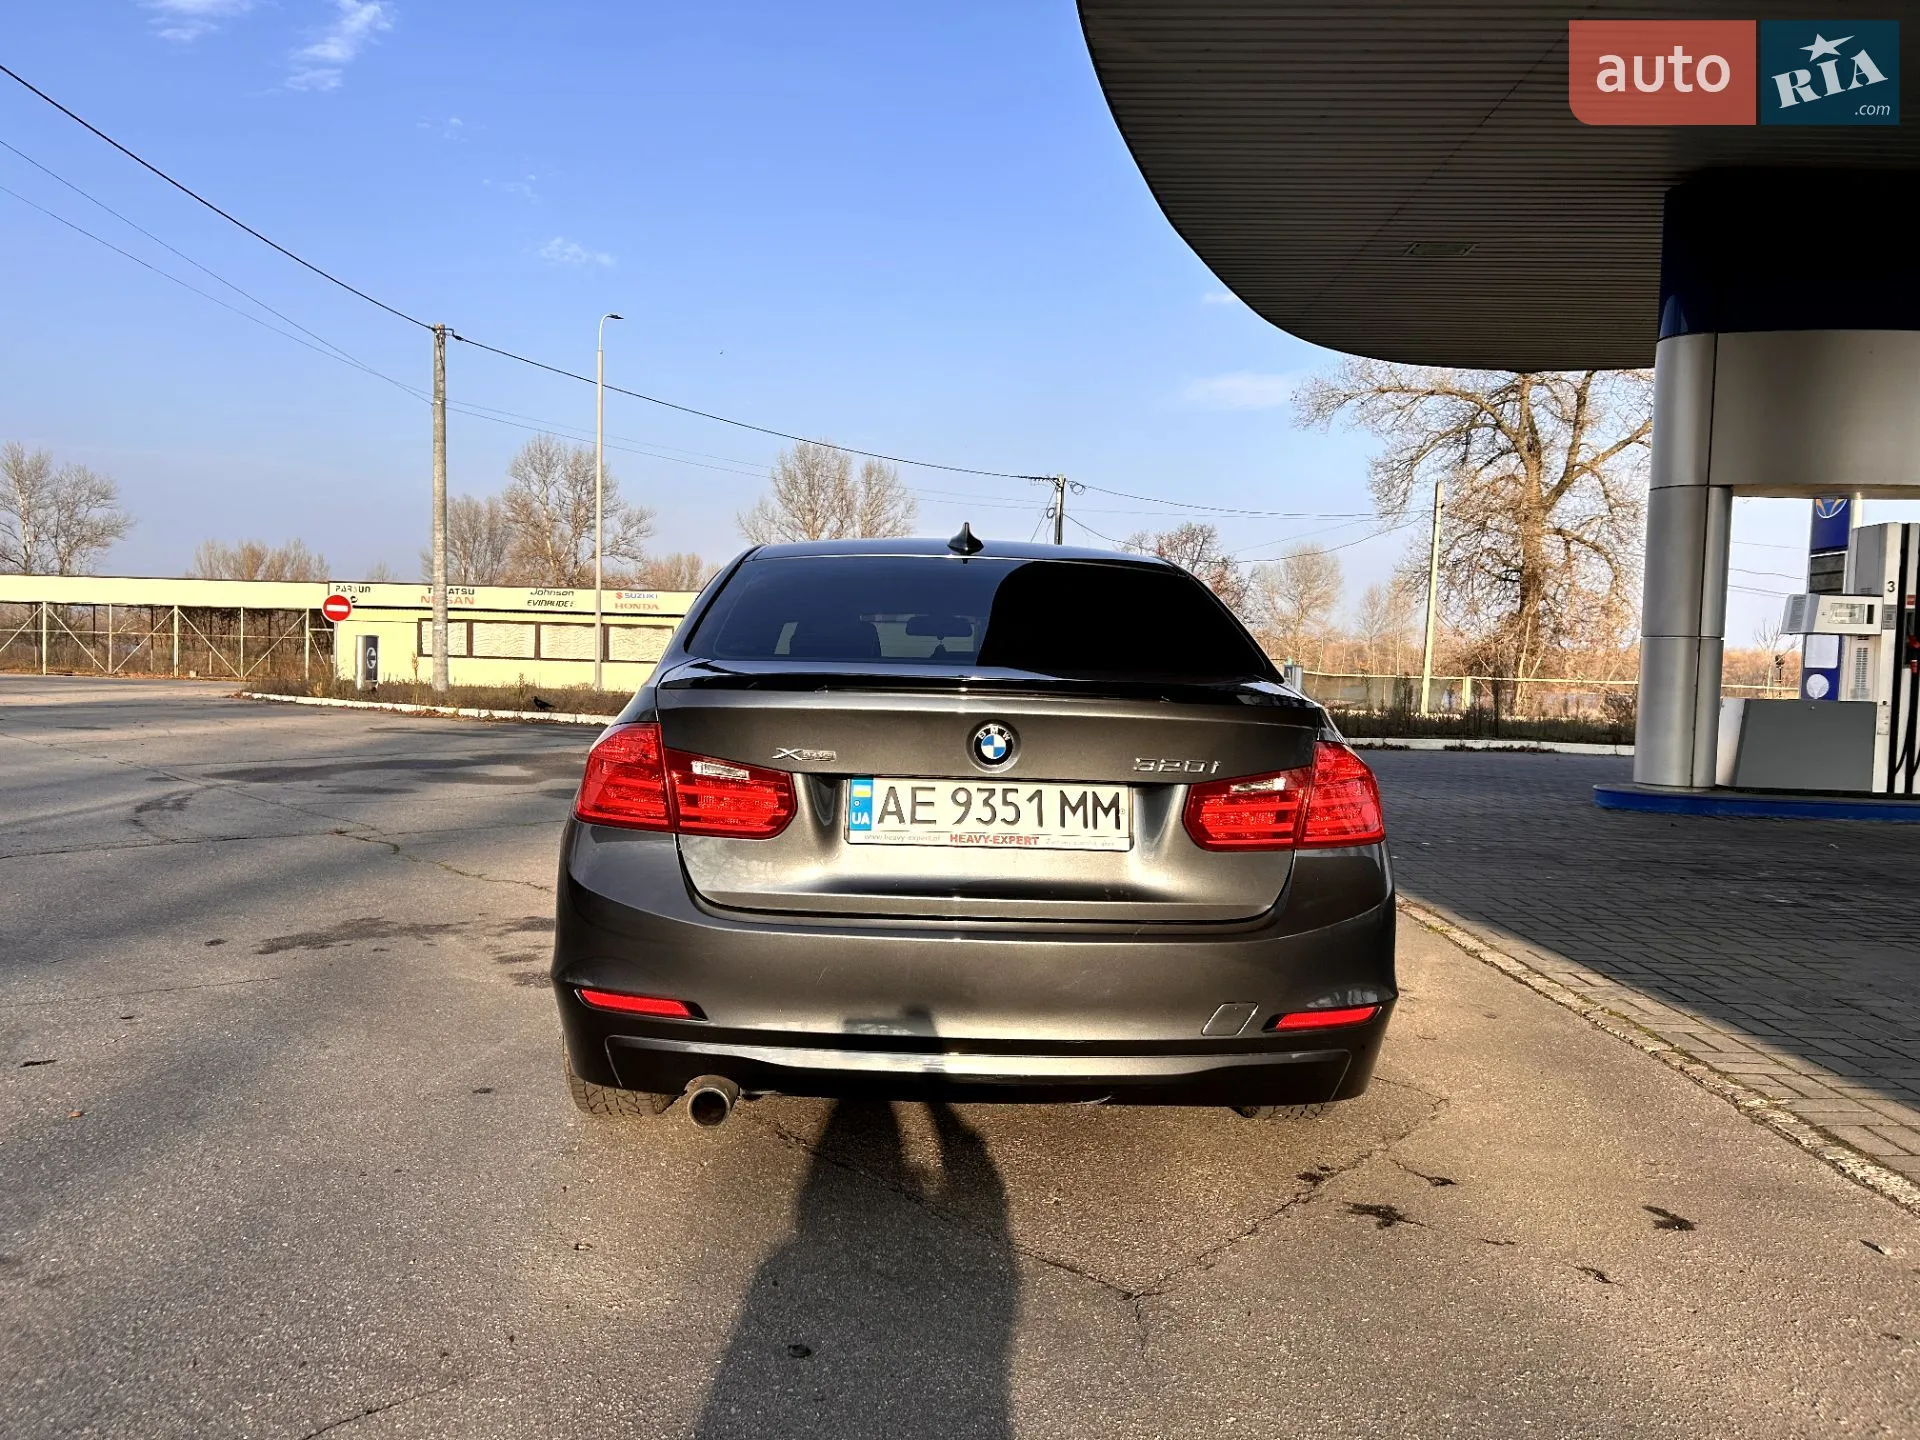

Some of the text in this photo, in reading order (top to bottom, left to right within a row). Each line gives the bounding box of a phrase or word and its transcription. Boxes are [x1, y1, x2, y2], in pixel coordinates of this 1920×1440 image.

[427, 587, 475, 595] TATSU
[530, 588, 575, 596] Johnson
[1887, 580, 1896, 593] 3
[977, 725, 1011, 741] BMW
[877, 786, 1121, 831] AE 9351 MM
[851, 811, 870, 826] UA
[949, 834, 1040, 846] HEAVY-EXPERT
